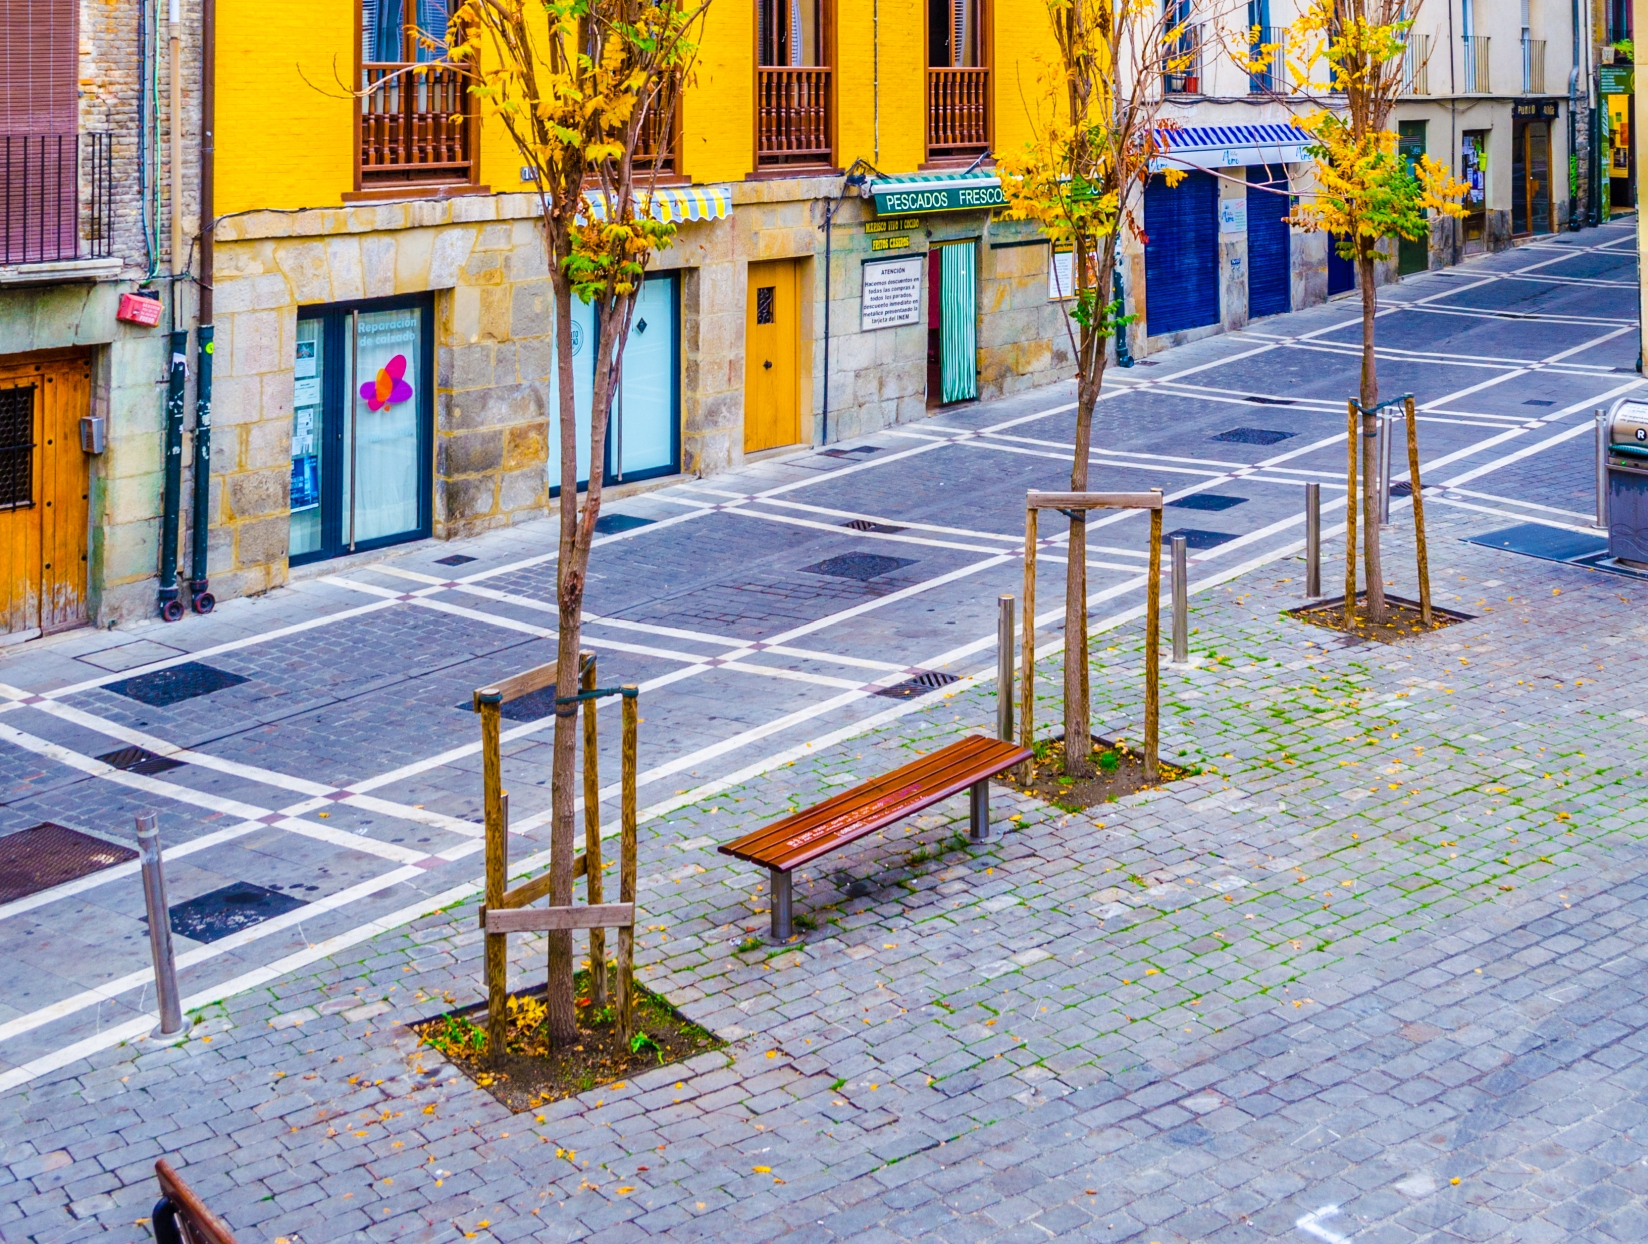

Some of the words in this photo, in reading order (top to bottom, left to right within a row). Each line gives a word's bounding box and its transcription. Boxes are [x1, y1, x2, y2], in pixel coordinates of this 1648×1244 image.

[886, 192, 948, 210] PESCADOS
[959, 188, 1009, 204] FRESCOS
[358, 318, 416, 333] Reparación
[360, 335, 373, 346] de
[376, 331, 415, 344] calzado
